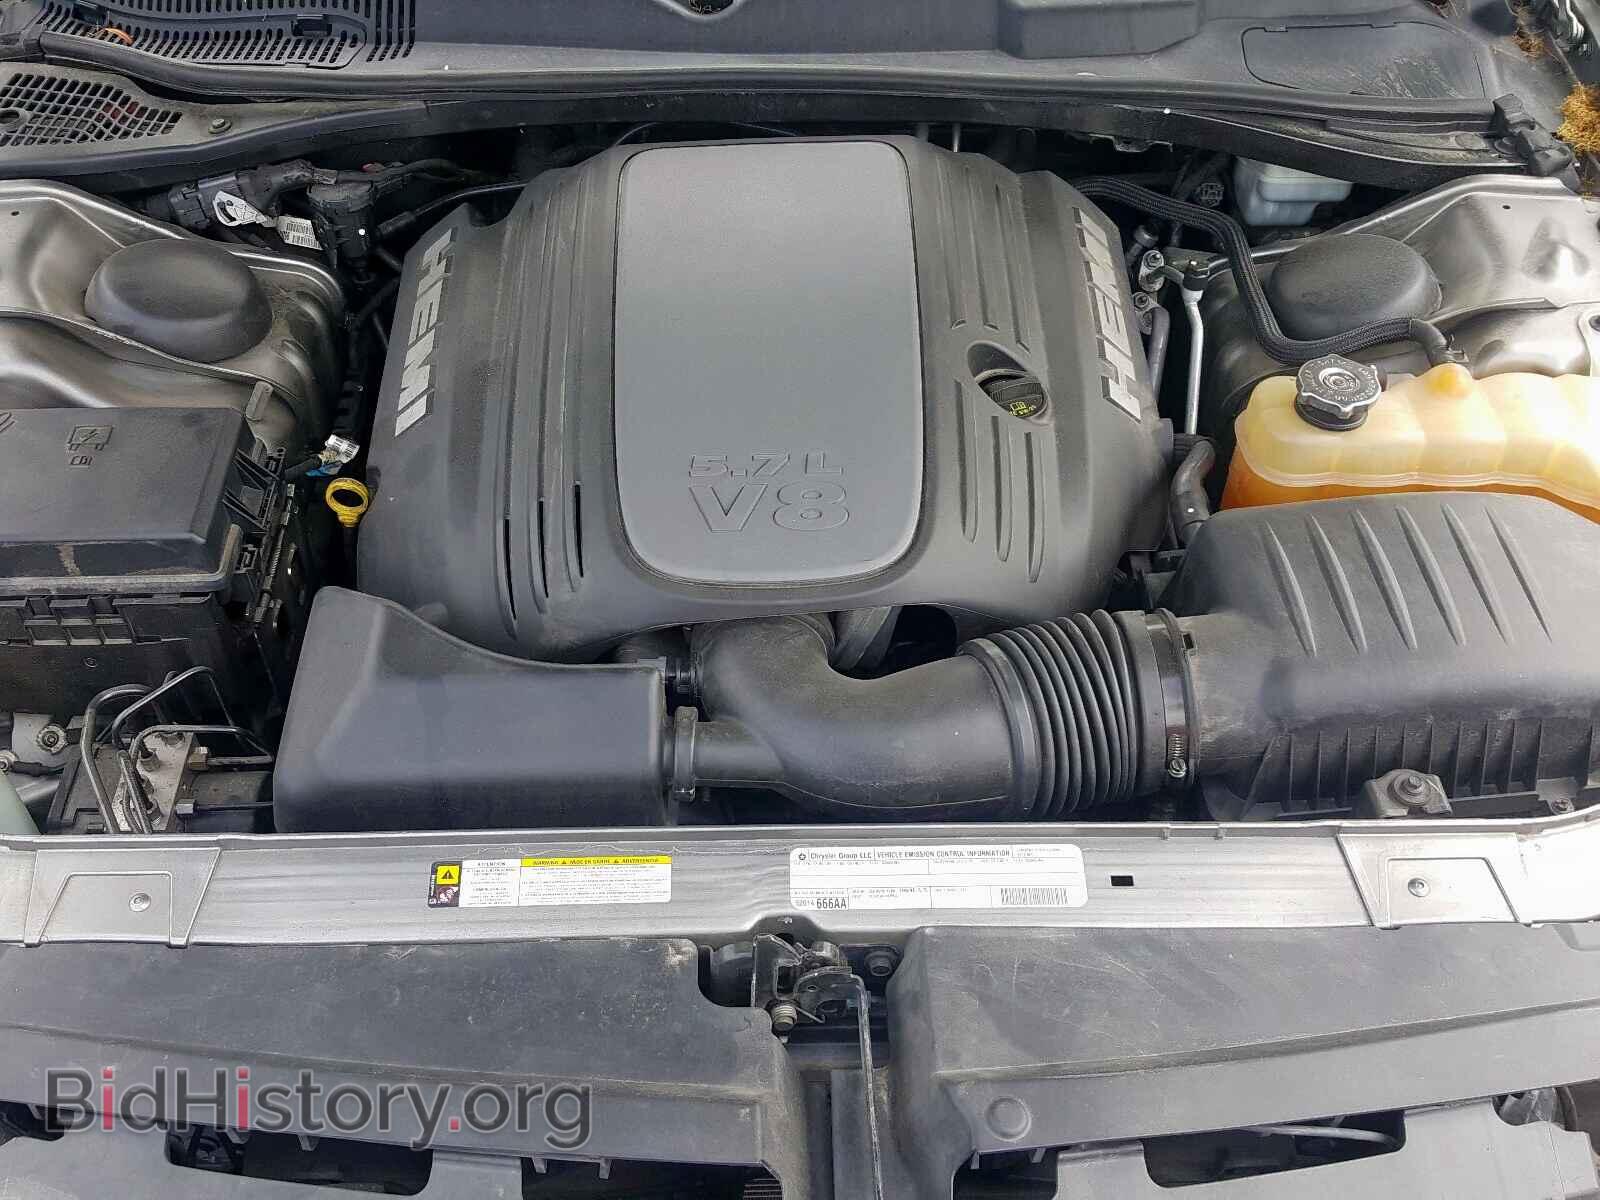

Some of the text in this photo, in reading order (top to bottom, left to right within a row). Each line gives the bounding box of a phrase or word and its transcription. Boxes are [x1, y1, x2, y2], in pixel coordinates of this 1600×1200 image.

[1075, 207, 1142, 422] HEMI
[394, 228, 454, 437] HEMI
[688, 452, 844, 477] 5.7L
[688, 482, 850, 533] V8
[810, 852, 836, 862] Chrysler
[839, 852, 858, 860] Group
[936, 850, 965, 858] CONTROL
[816, 898, 847, 909] 666AA
